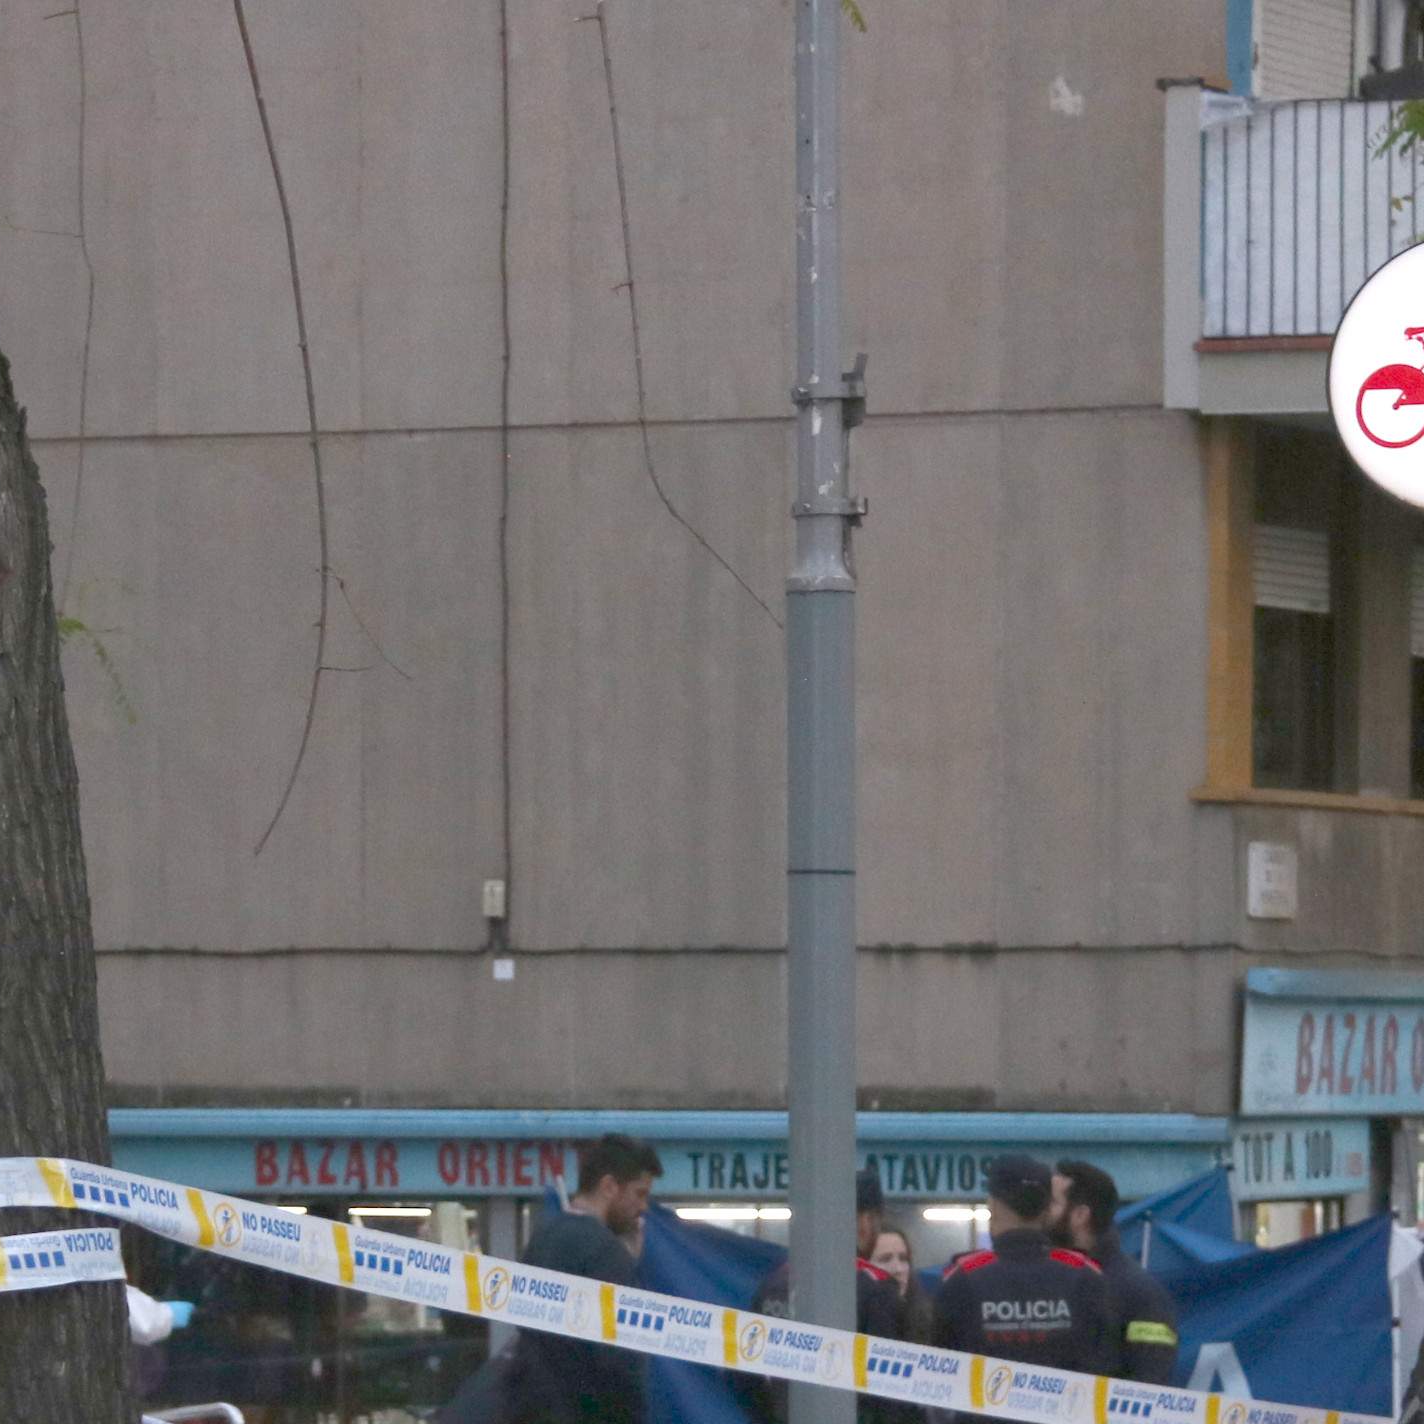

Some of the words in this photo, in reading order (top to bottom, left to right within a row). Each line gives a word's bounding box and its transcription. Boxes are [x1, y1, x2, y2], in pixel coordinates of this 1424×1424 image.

[1296, 1011, 1398, 1095] BAZAR
[255, 1140, 399, 1188] BAZAR
[437, 1140, 588, 1188] ORIEN
[1241, 1132, 1273, 1183] TOT
[1283, 1131, 1295, 1181] A
[130, 1182, 179, 1209] POLICIA
[242, 1211, 258, 1231] NO
[260, 1217, 301, 1242] PASSEU
[63, 1234, 114, 1253] POLICIA
[406, 1247, 451, 1275] POLICIA
[511, 1274, 526, 1293] NO
[528, 1278, 569, 1303] PASSEU
[668, 1306, 712, 1328] POLICIA
[982, 1300, 1071, 1320] POLICIA
[767, 1327, 782, 1344] NO
[784, 1330, 823, 1351] PASSEU
[917, 1353, 959, 1376] POLICIA
[1013, 1372, 1027, 1389] NO
[1029, 1374, 1067, 1395] PASSEU
[1157, 1391, 1196, 1414] POLICIA
